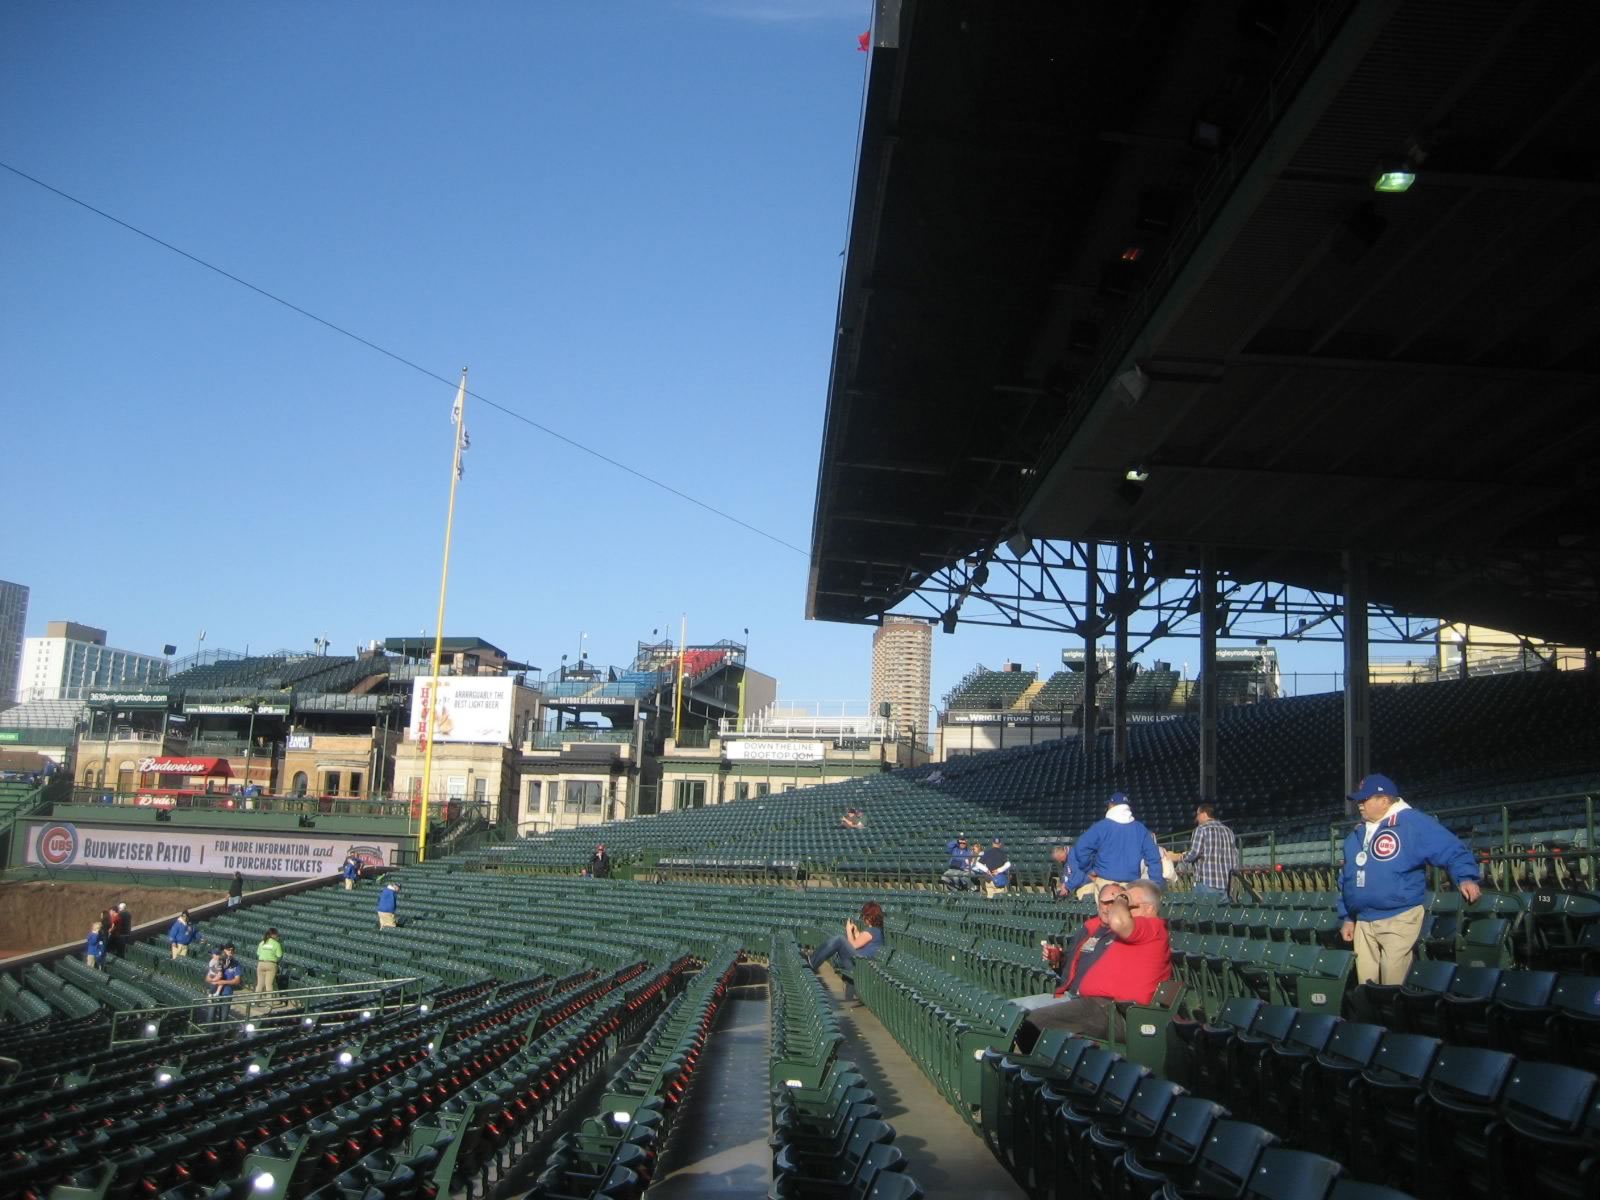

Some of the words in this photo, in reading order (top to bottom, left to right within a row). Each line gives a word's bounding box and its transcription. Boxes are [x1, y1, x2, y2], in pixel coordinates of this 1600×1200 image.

[494, 691, 504, 699] THE
[454, 700, 468, 708] BEST
[468, 700, 484, 709] LIGHT
[138, 758, 206, 772] Budweiser
[42, 827, 74, 864] CUBS
[84, 838, 153, 862] BUDWEISER
[157, 842, 191, 864] PATIO
[214, 840, 229, 853] FOR
[231, 841, 253, 854] MORE
[255, 842, 310, 857] INFORMATION
[312, 845, 334, 858] and
[223, 856, 234, 869] TO
[236, 857, 282, 872] PURCHASE
[285, 860, 323, 874] TICKETS
